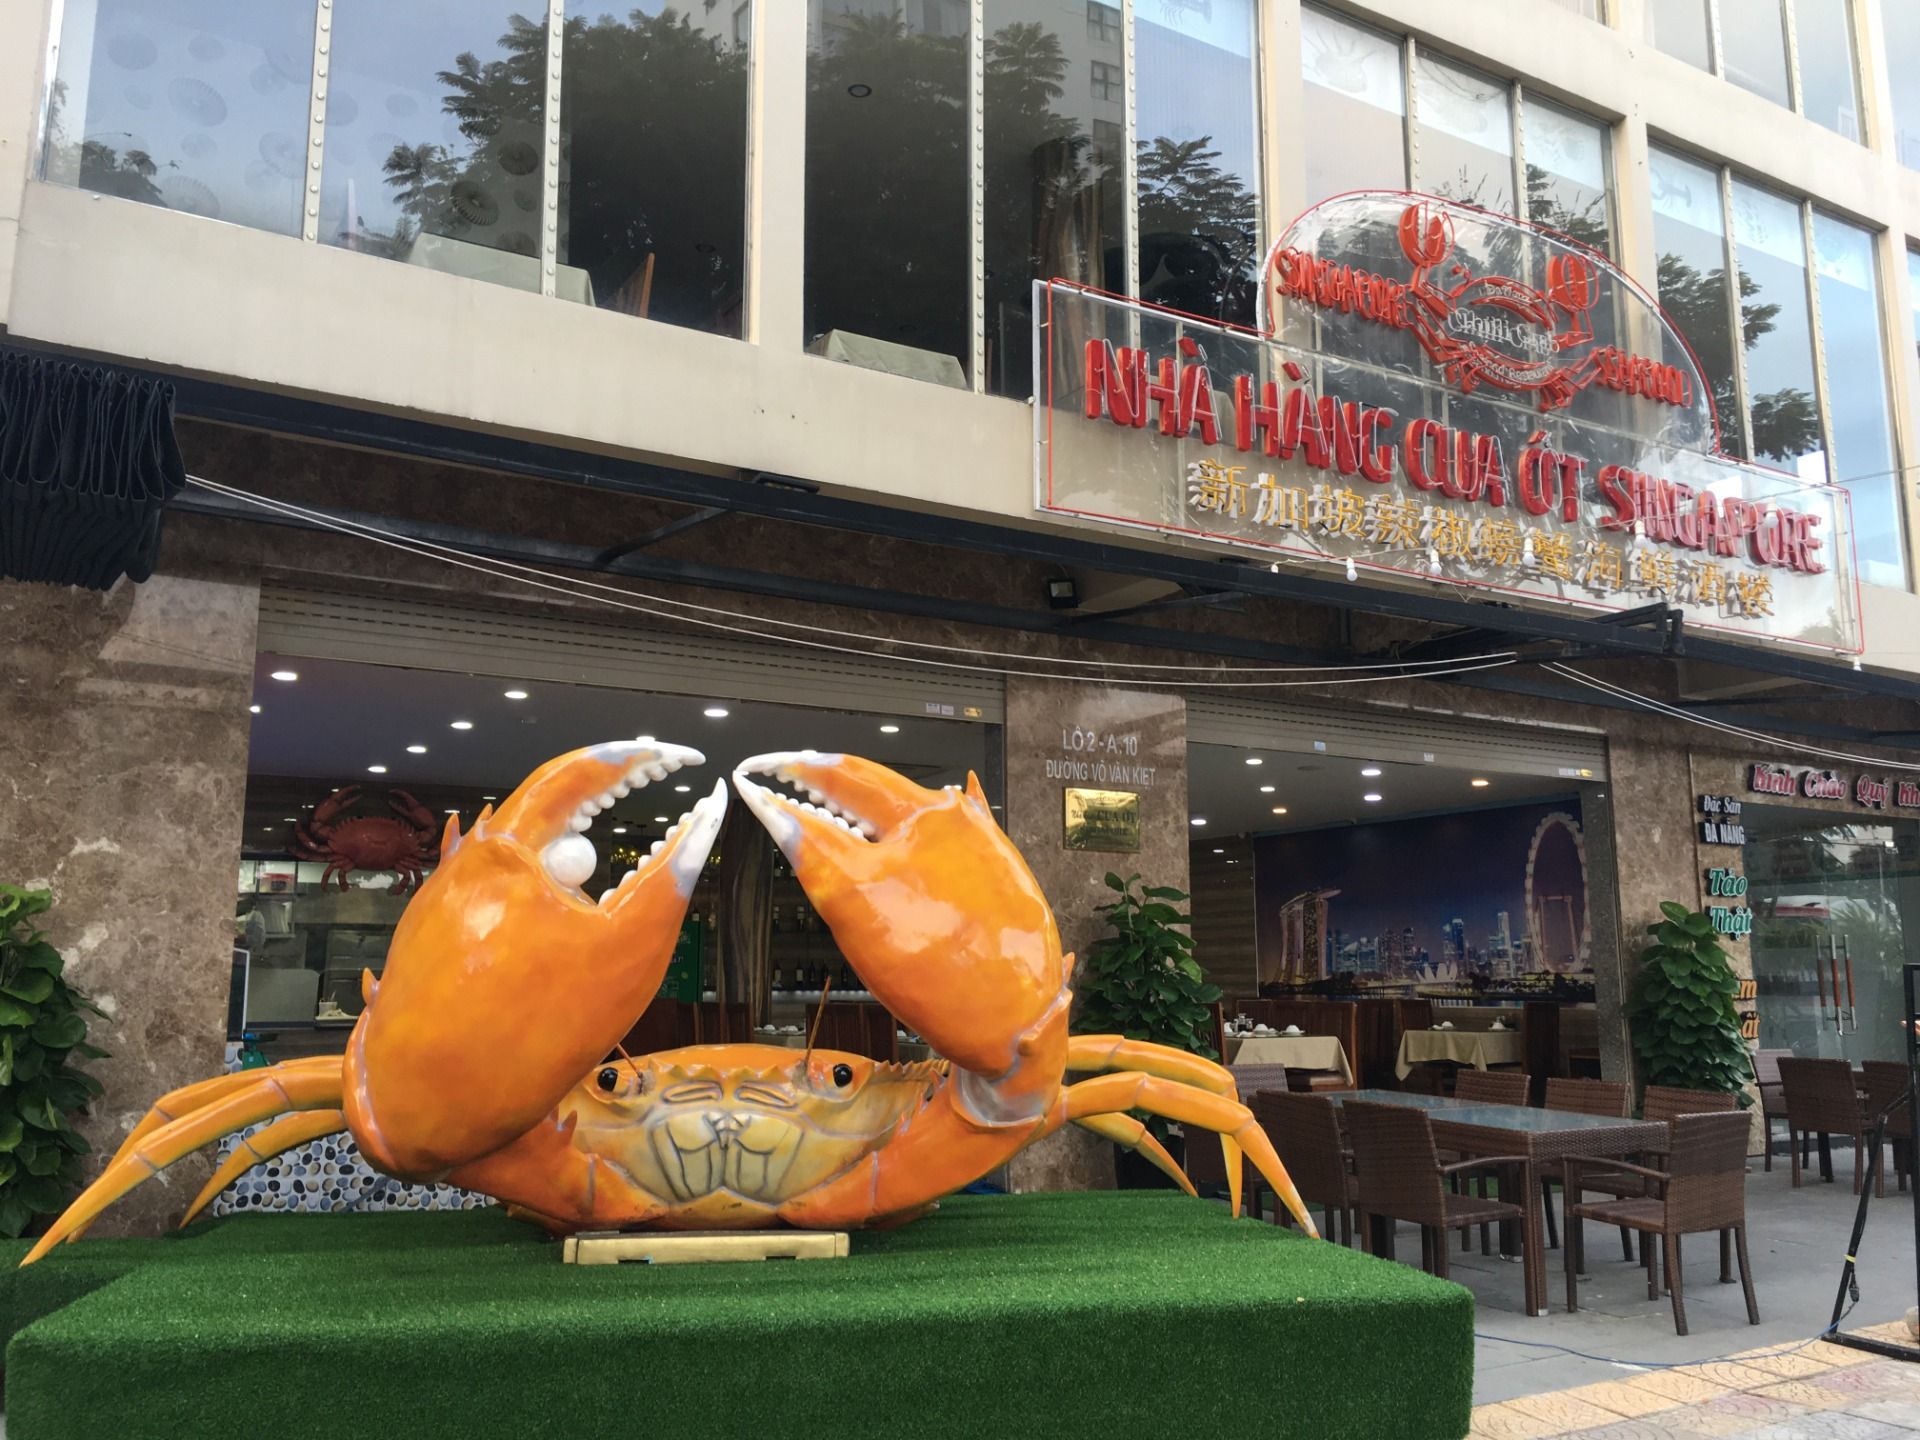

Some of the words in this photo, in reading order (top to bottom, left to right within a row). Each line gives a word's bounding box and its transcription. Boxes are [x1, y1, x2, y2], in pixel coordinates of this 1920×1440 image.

[1085, 337, 1222, 445] NHÀ
[1234, 360, 1399, 484] HÀNG
[1598, 463, 1827, 575] SINGAPORE
